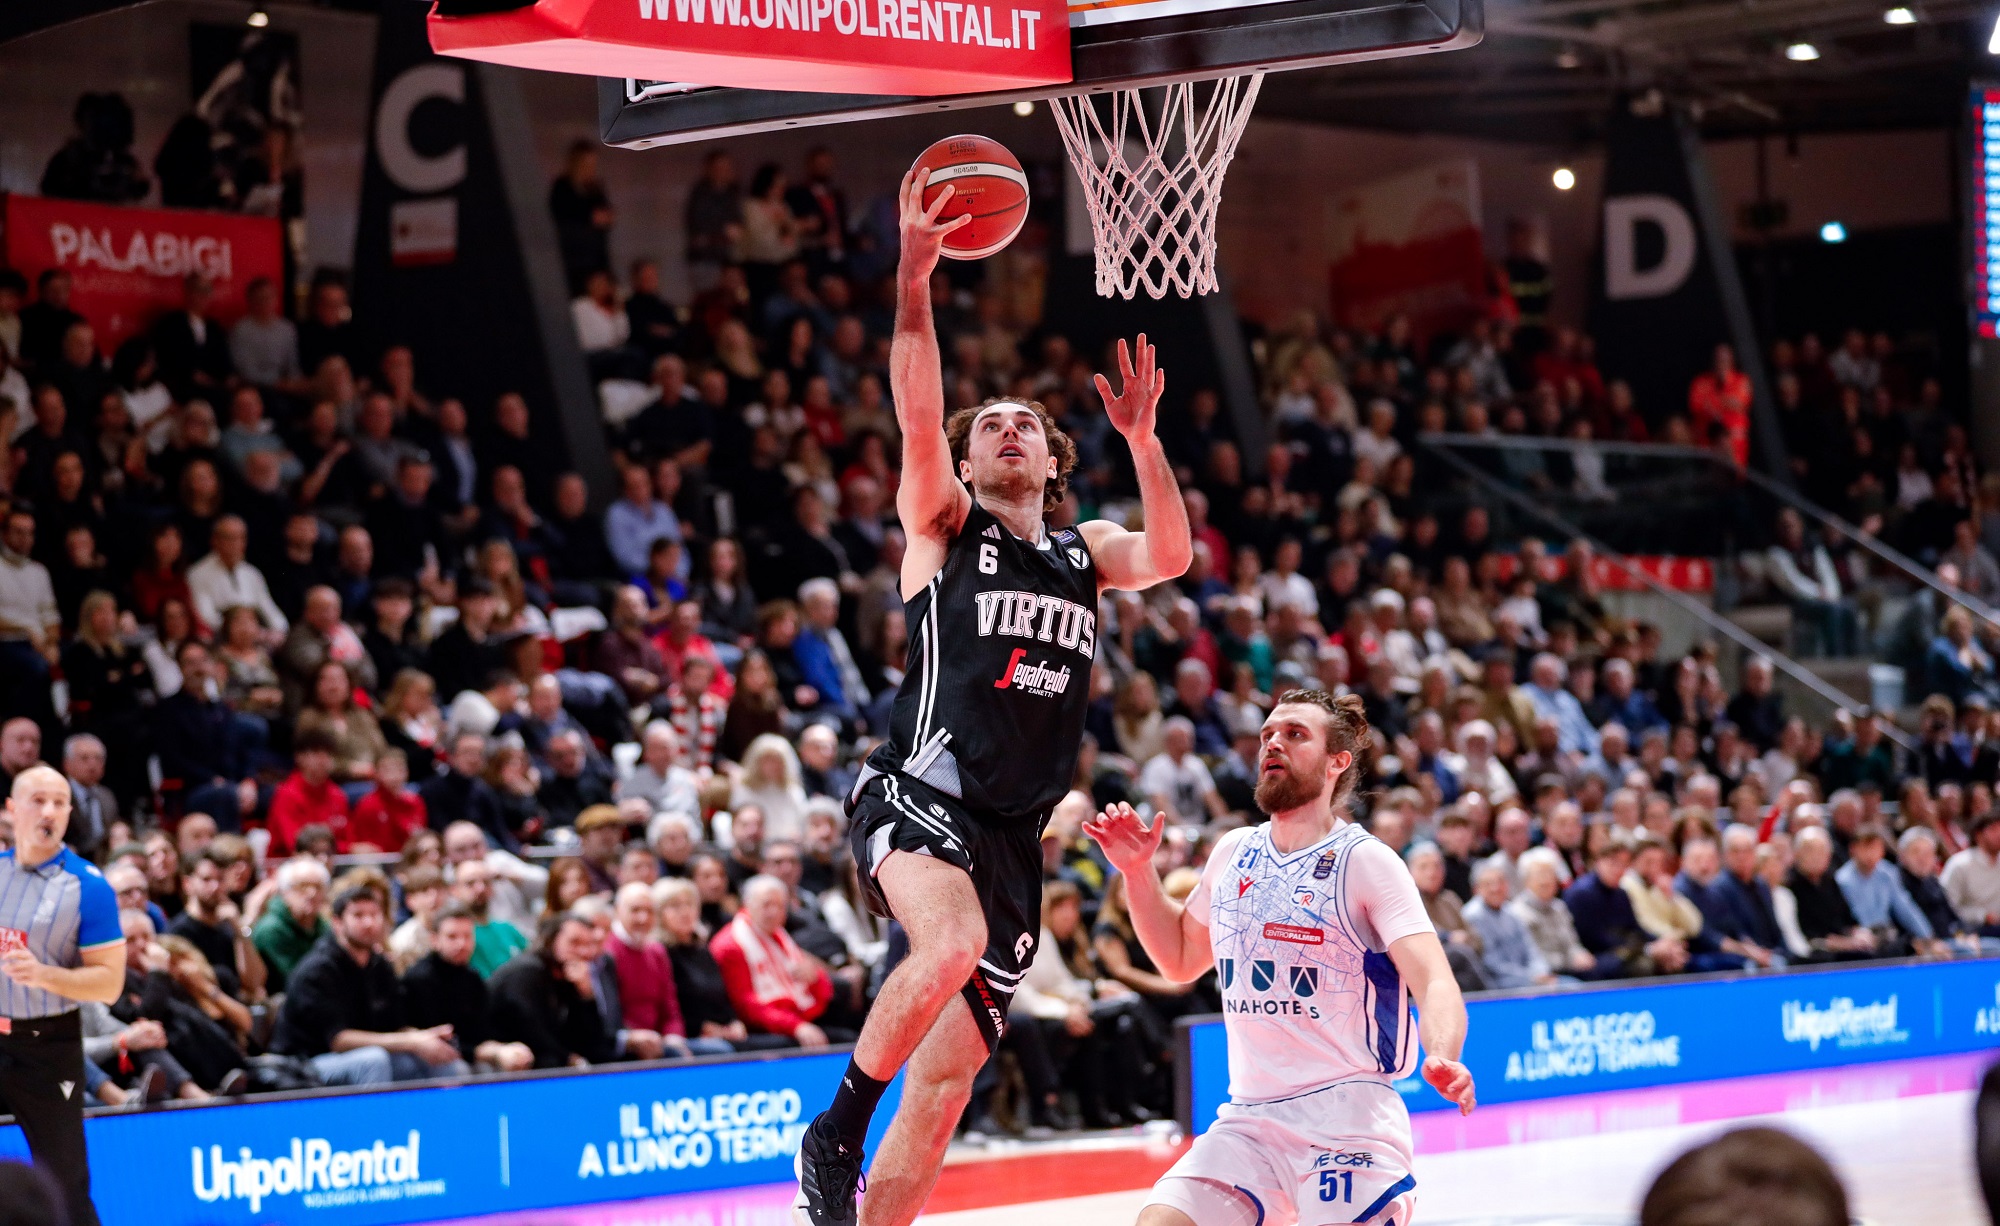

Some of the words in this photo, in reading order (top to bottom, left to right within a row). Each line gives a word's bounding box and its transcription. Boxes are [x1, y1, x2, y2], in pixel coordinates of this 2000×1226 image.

[376, 63, 467, 192] C
[51, 222, 233, 283] PALABIGI
[1604, 194, 1696, 299] D
[978, 543, 998, 575] 6
[975, 591, 1096, 660] VIRTUS
[994, 647, 1071, 694] Segafredo
[1027, 687, 1054, 698] ZANETTI
[1014, 931, 1034, 964] 6
[1504, 1050, 1523, 1082] A
[619, 1103, 650, 1139] IL
[651, 1087, 802, 1136] NOLEGGIO
[191, 1129, 420, 1214] UnipolRental
[577, 1142, 605, 1180] A
[606, 1131, 713, 1177] LUNGO
[1319, 1169, 1353, 1204] 51
